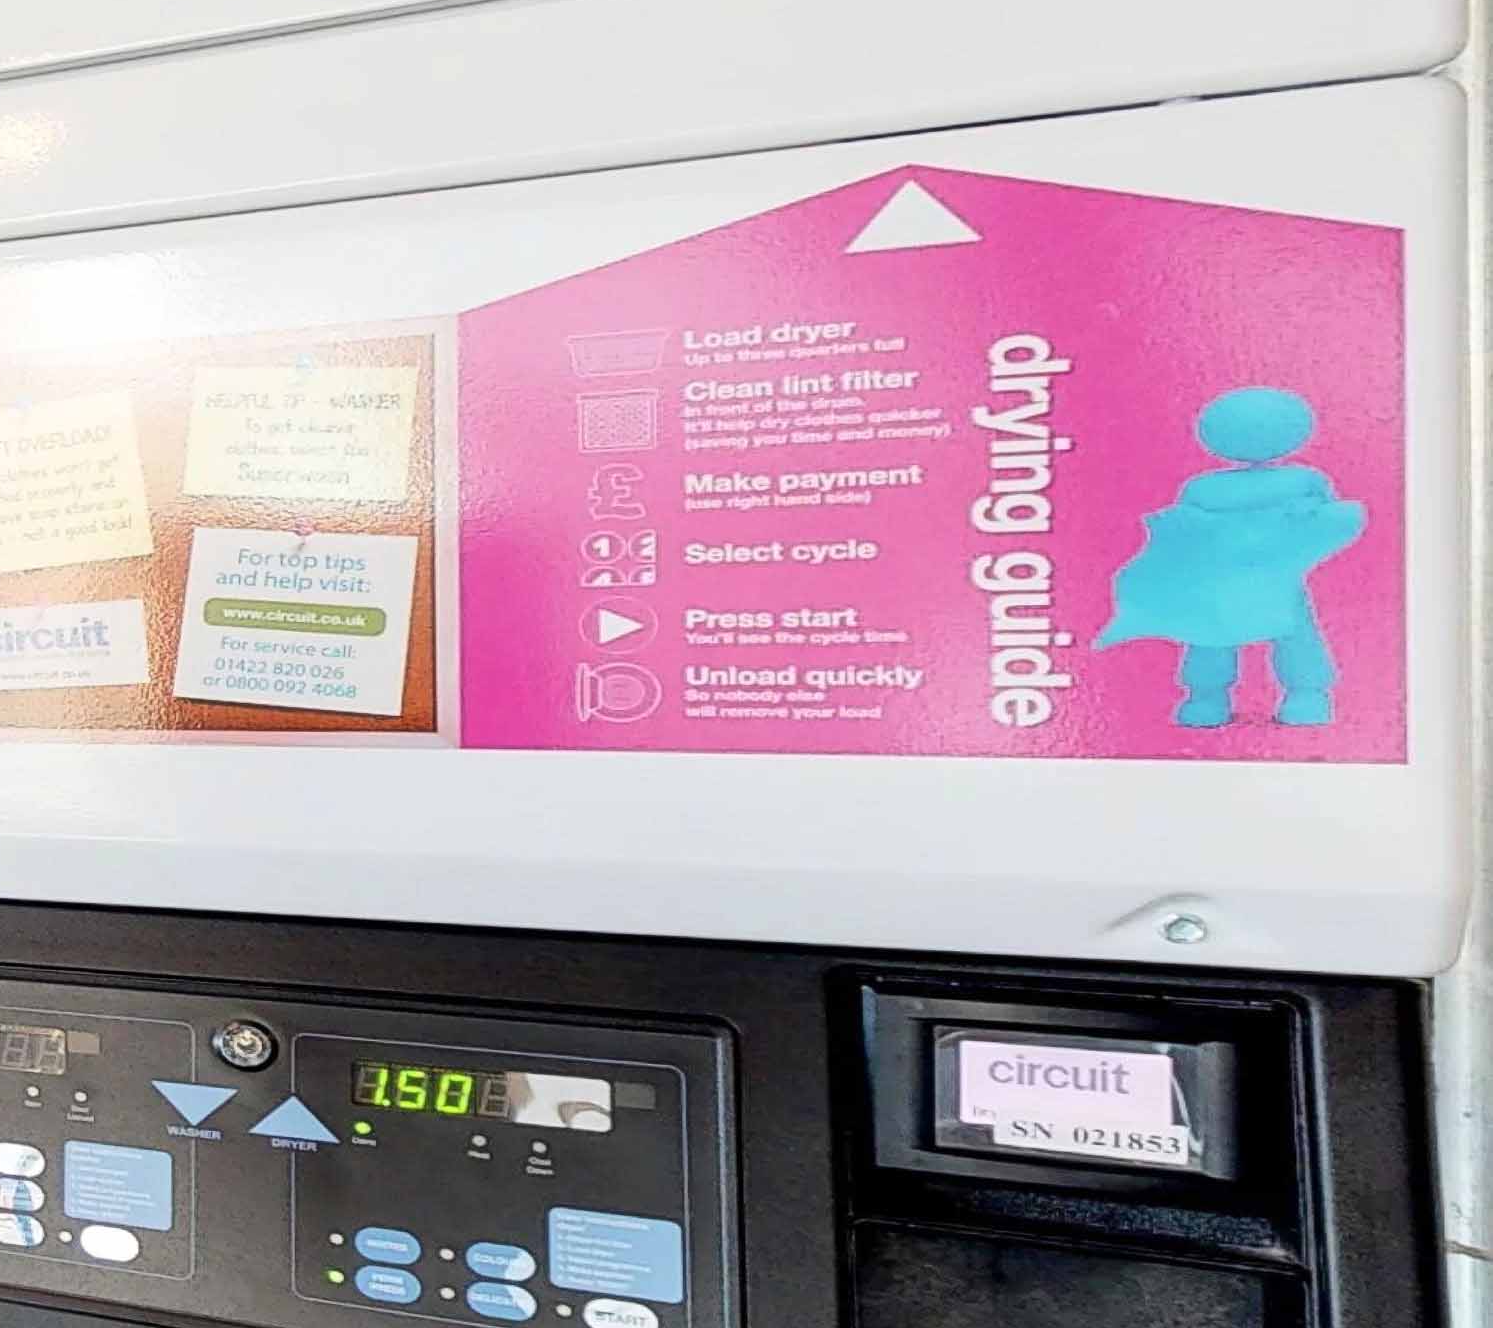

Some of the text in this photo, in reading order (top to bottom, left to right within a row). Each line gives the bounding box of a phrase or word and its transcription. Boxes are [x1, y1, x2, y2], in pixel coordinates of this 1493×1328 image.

[683, 320, 857, 349] Load dryer
[684, 369, 920, 402] Clean lint filter
[684, 464, 924, 494] Make payment
[970, 332, 1072, 729] drying guide
[238, 548, 367, 573] For top tips
[684, 539, 878, 564] Select cycle
[216, 570, 371, 594] and help visit:
[222, 606, 367, 628] www.circuit.co.uk
[684, 608, 859, 629] Press start
[221, 635, 356, 659] For service call:
[213, 657, 345, 680] 01422 820 026
[684, 664, 923, 690] Unload quickly
[202, 675, 357, 699] or 0800 092 4068
[987, 1053, 1132, 1095] circuit
[373, 1064, 475, 1116] 1.50
[166, 1123, 223, 1141] WASHER
[270, 1135, 319, 1153] DRYER
[1010, 1120, 1182, 1155] SN 021853
